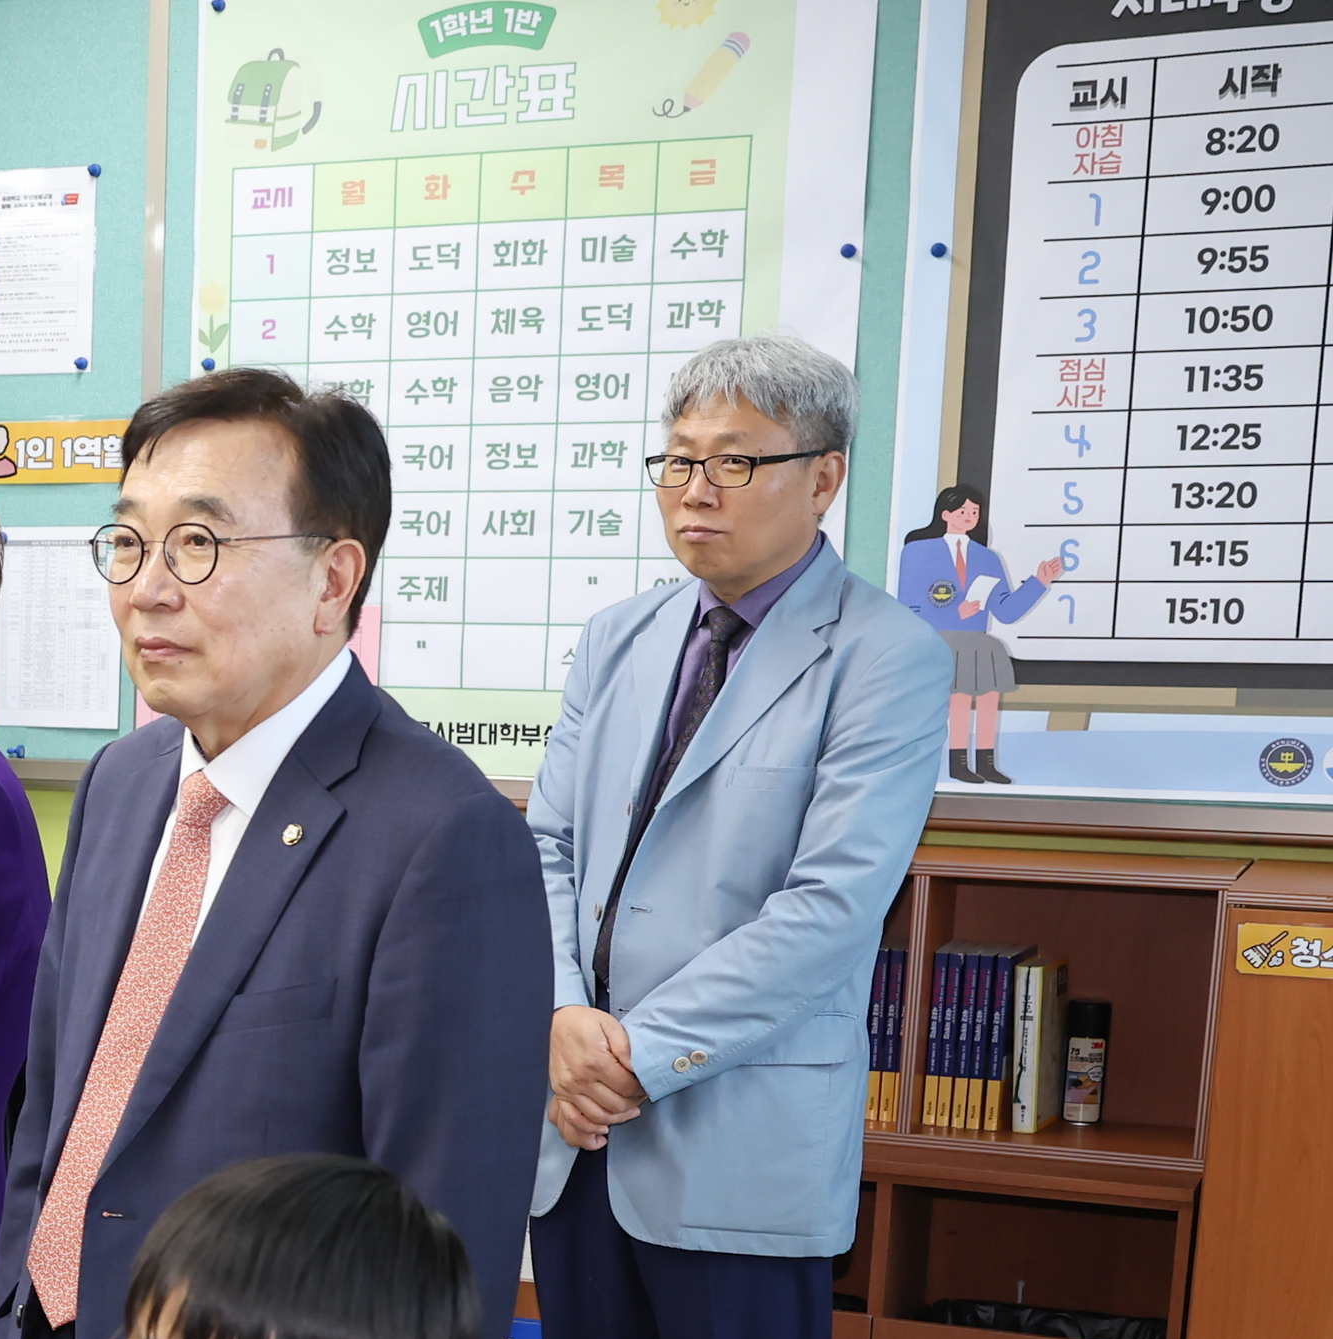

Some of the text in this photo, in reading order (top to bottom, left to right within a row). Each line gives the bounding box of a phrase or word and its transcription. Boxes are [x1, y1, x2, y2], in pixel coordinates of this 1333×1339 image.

[430, 5, 543, 44] 1학년 1반
[390, 60, 578, 133] 시간표
[1069, 64, 1282, 111] 교시 시작
[1075, 125, 1123, 150] 아침
[1205, 124, 1280, 156] 8:20
[1072, 152, 1122, 176] 자습
[251, 158, 718, 211] 교시 월 화 수 목 금
[1201, 184, 1276, 216] 9:00
[1088, 193, 1102, 227] 1
[264, 228, 730, 276] 1 정보 도덕 회화 미술 수학
[1077, 250, 1102, 285] 2
[1196, 245, 1270, 275] 9:55
[260, 298, 726, 341] 2 수학 영어 체육 도덕 과학
[1074, 308, 1097, 342] 3
[1185, 305, 1273, 334] 10:50
[1058, 358, 1106, 382] 점심
[1185, 364, 1264, 393] 11:35
[404, 375, 458, 406] 수학
[487, 373, 544, 404] 음악
[573, 372, 631, 402] 영어
[1056, 384, 1106, 408] 시간
[16, 435, 123, 470] 1인 1역할
[1065, 425, 1091, 458] 4
[1177, 424, 1262, 451] 12:25
[402, 440, 628, 473] 국어 정보 과학
[1062, 482, 1083, 515] 5
[1171, 482, 1258, 509] 13:20
[398, 508, 624, 540] 국어 사회 기술
[1060, 538, 1080, 572] 6
[1170, 541, 1250, 567] 14:15
[396, 575, 450, 603] 주제
[1058, 595, 1076, 625] 7
[1165, 598, 1245, 625] 15:10
[1070, 1047, 1081, 1056] 75
